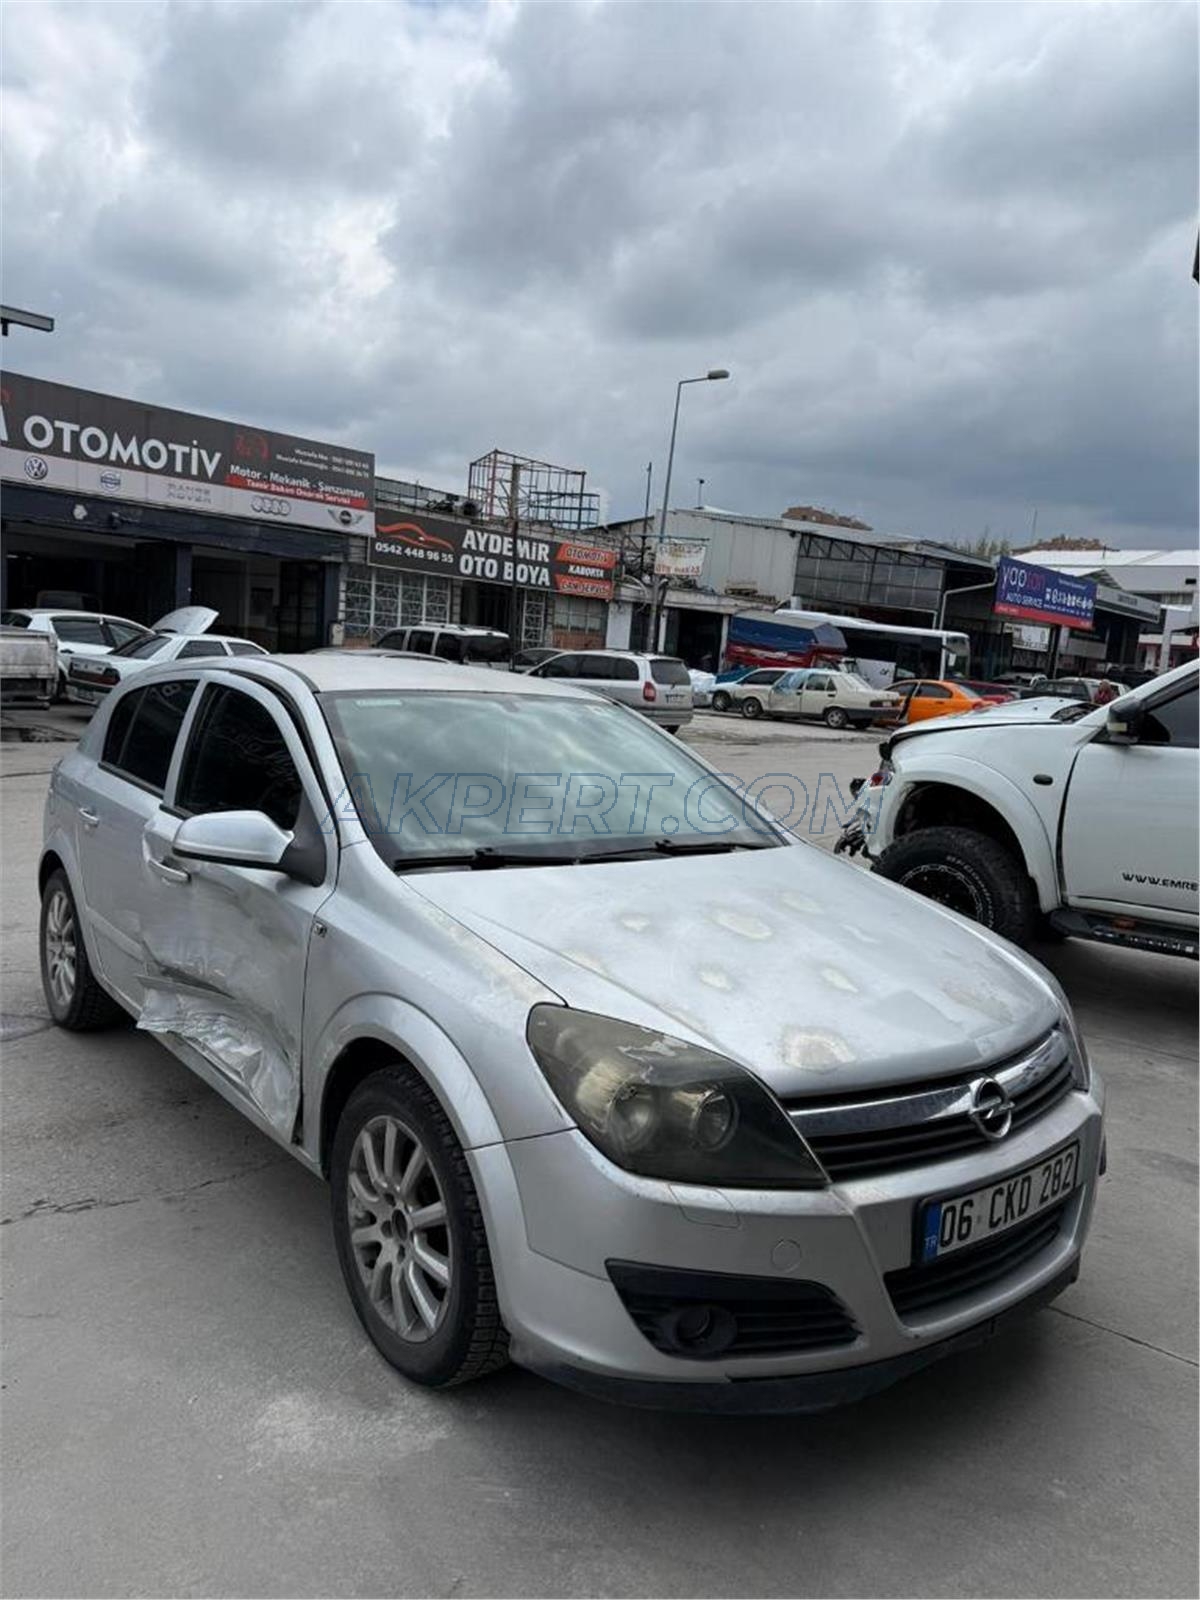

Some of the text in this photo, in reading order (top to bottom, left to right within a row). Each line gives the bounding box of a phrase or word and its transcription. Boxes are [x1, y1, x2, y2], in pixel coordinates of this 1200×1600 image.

[23, 414, 222, 480] OTOMOTİV
[230, 464, 262, 480] Motor
[404, 548, 424, 559] 448
[459, 554, 497, 579] OTO
[503, 562, 551, 587] BOYA
[940, 1152, 1075, 1248] 06 CKD 282
